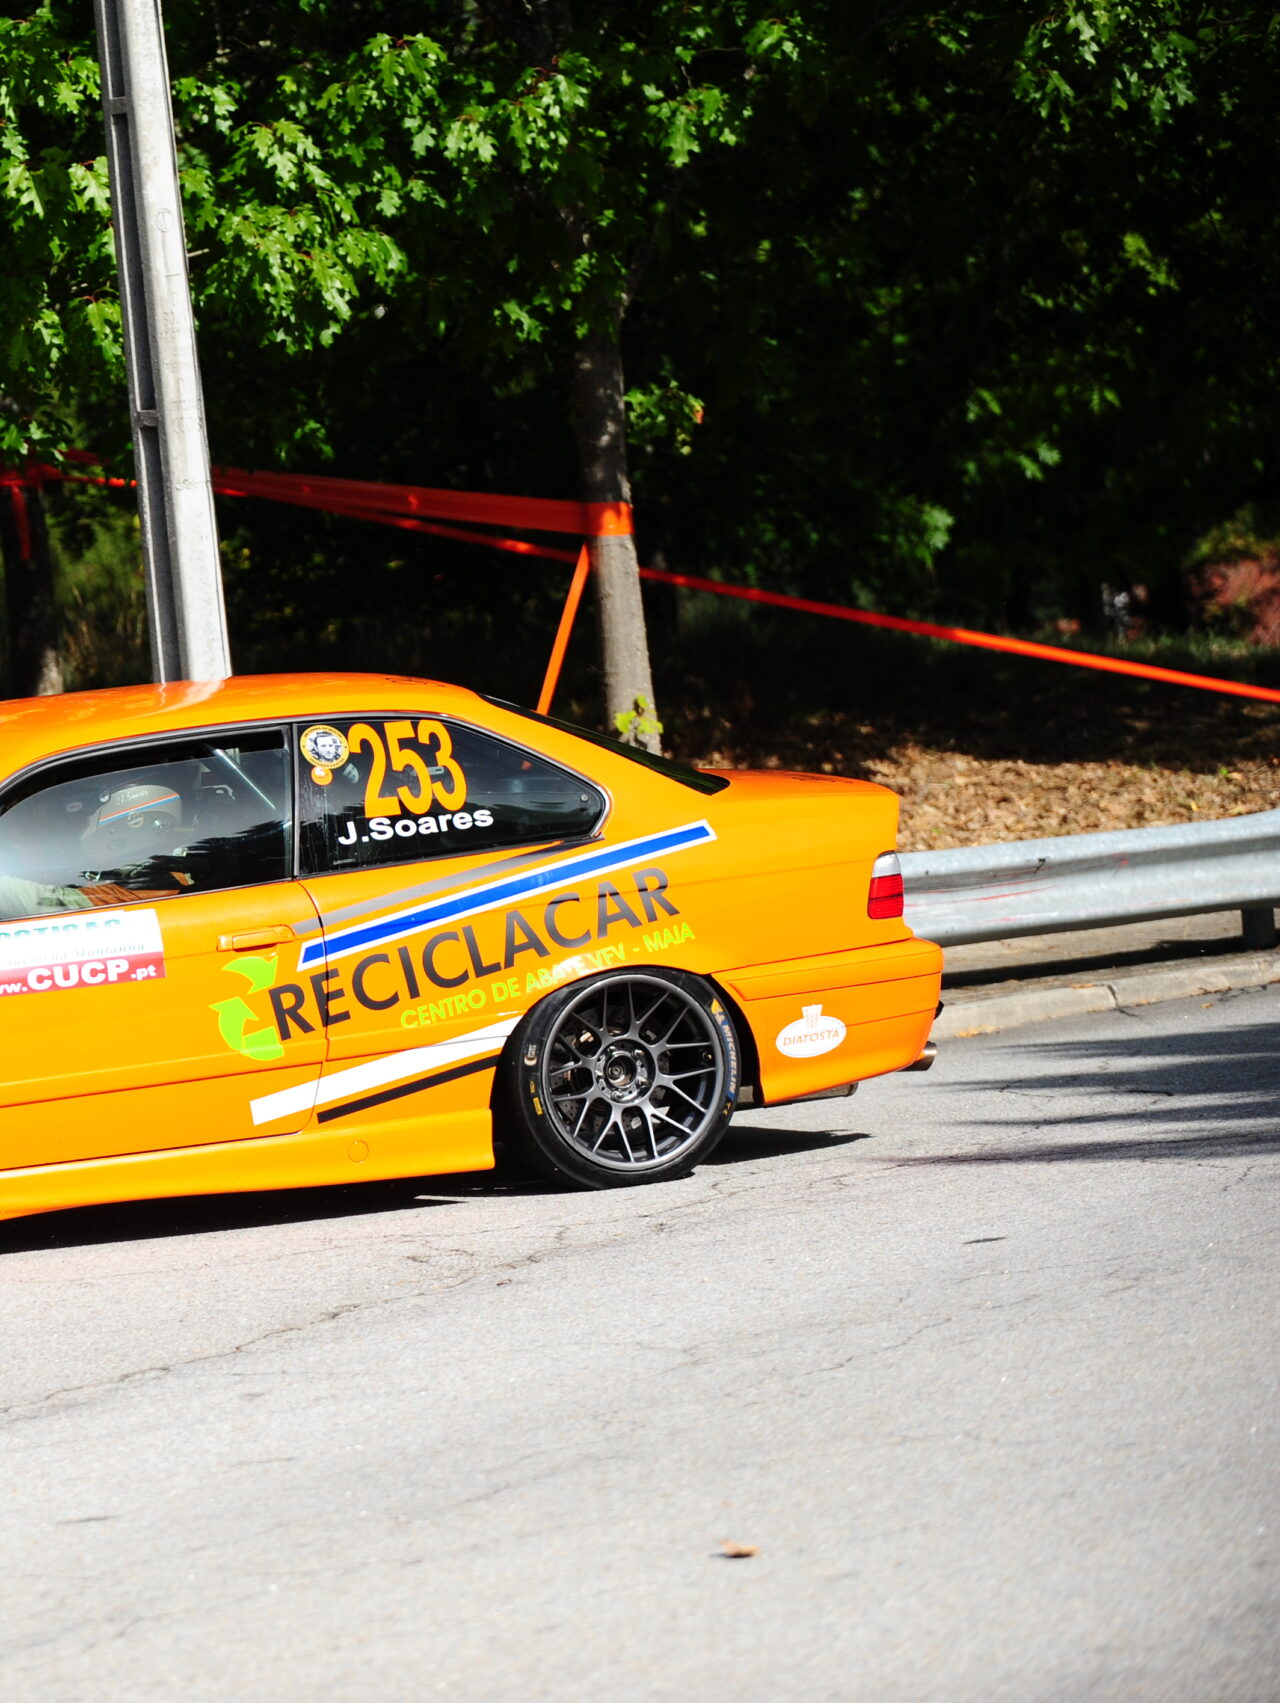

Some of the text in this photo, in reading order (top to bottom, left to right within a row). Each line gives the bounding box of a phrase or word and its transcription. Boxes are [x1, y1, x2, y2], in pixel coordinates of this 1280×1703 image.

[347, 719, 467, 818] 253
[337, 809, 494, 845] J.Soares
[267, 866, 681, 1041] RECICLACAR
[401, 989, 486, 1028] CENTRO
[492, 981, 522, 1002] DE
[587, 943, 626, 967] VFV
[642, 922, 696, 952] MAIA
[722, 1023, 738, 1095] MICHELIN
[783, 1029, 839, 1047] DIATOSTA
